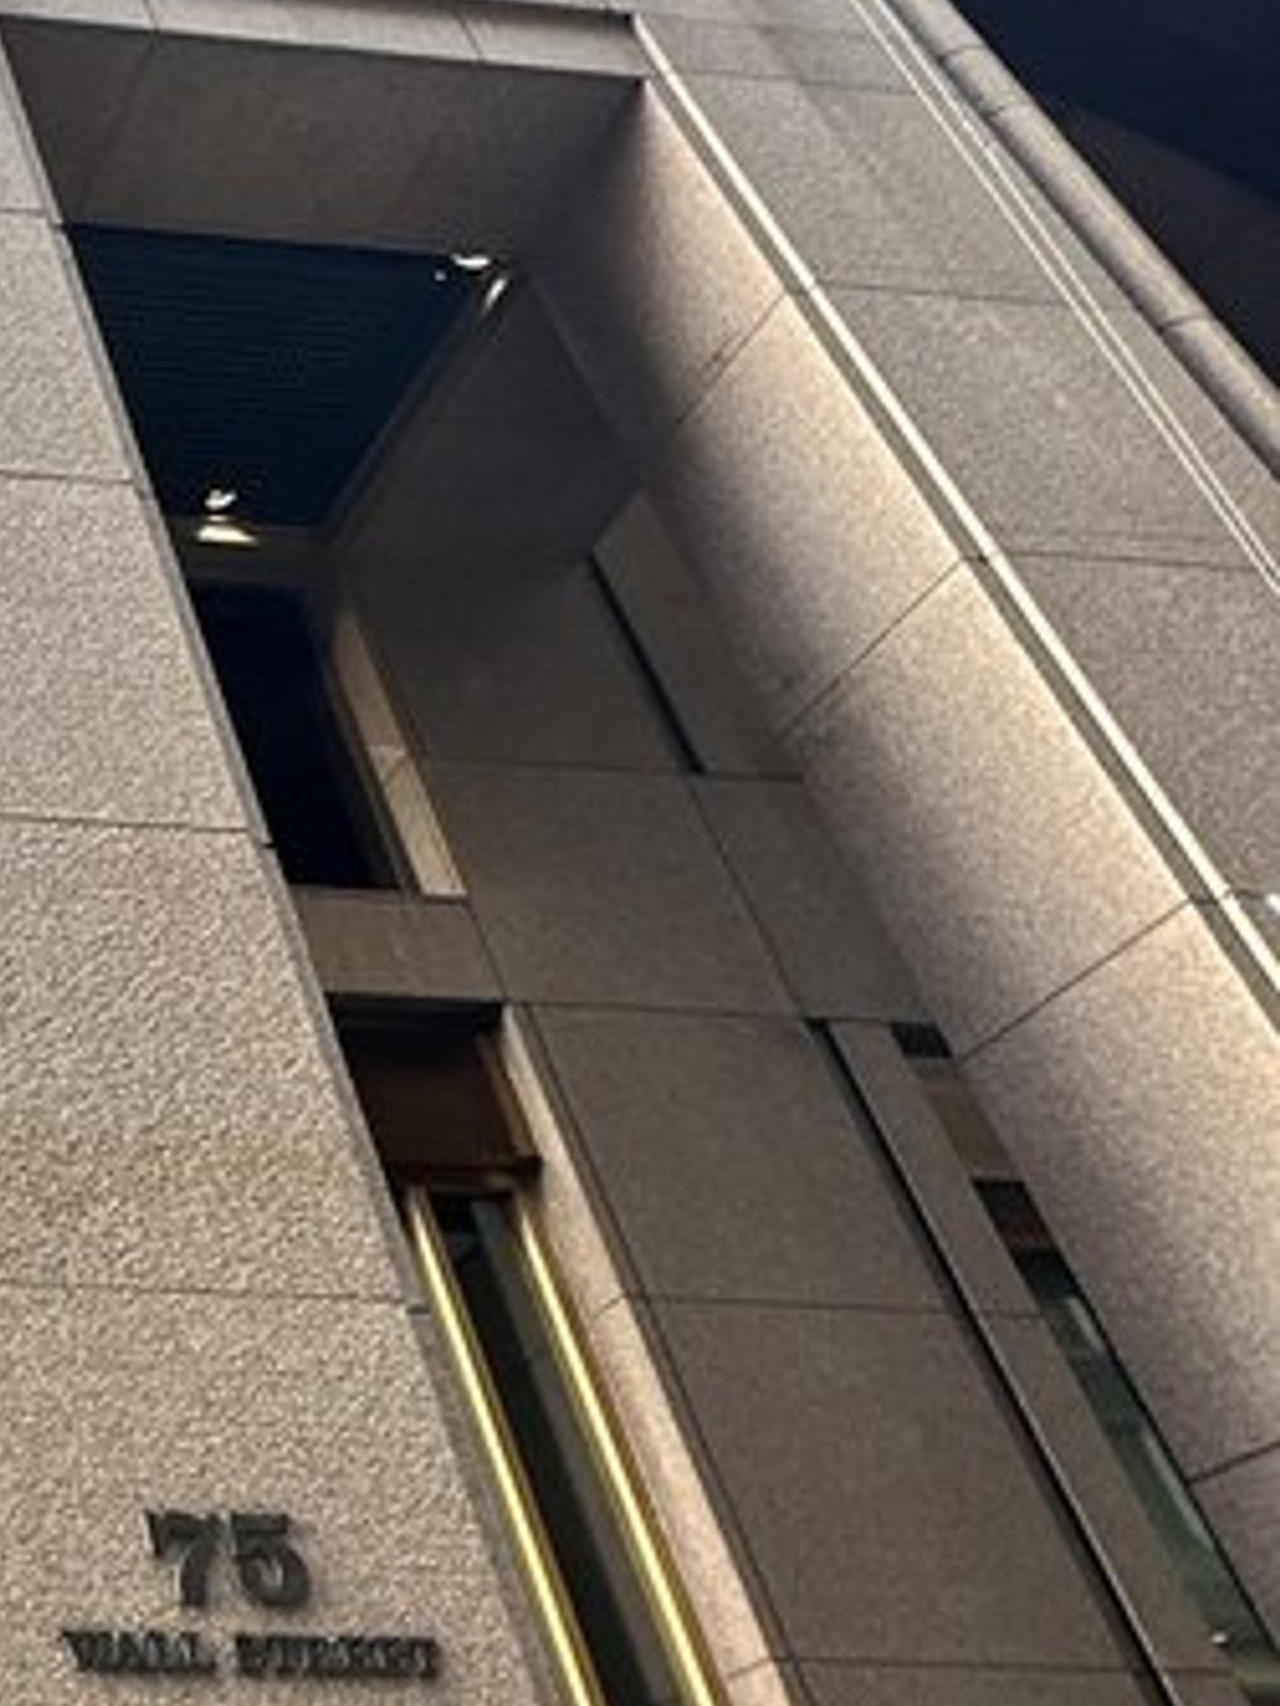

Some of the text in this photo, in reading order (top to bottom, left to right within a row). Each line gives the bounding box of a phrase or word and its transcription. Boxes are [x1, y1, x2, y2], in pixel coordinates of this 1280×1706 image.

[142, 1507, 311, 1609] 75
[60, 1630, 441, 1679] WALL STREET
